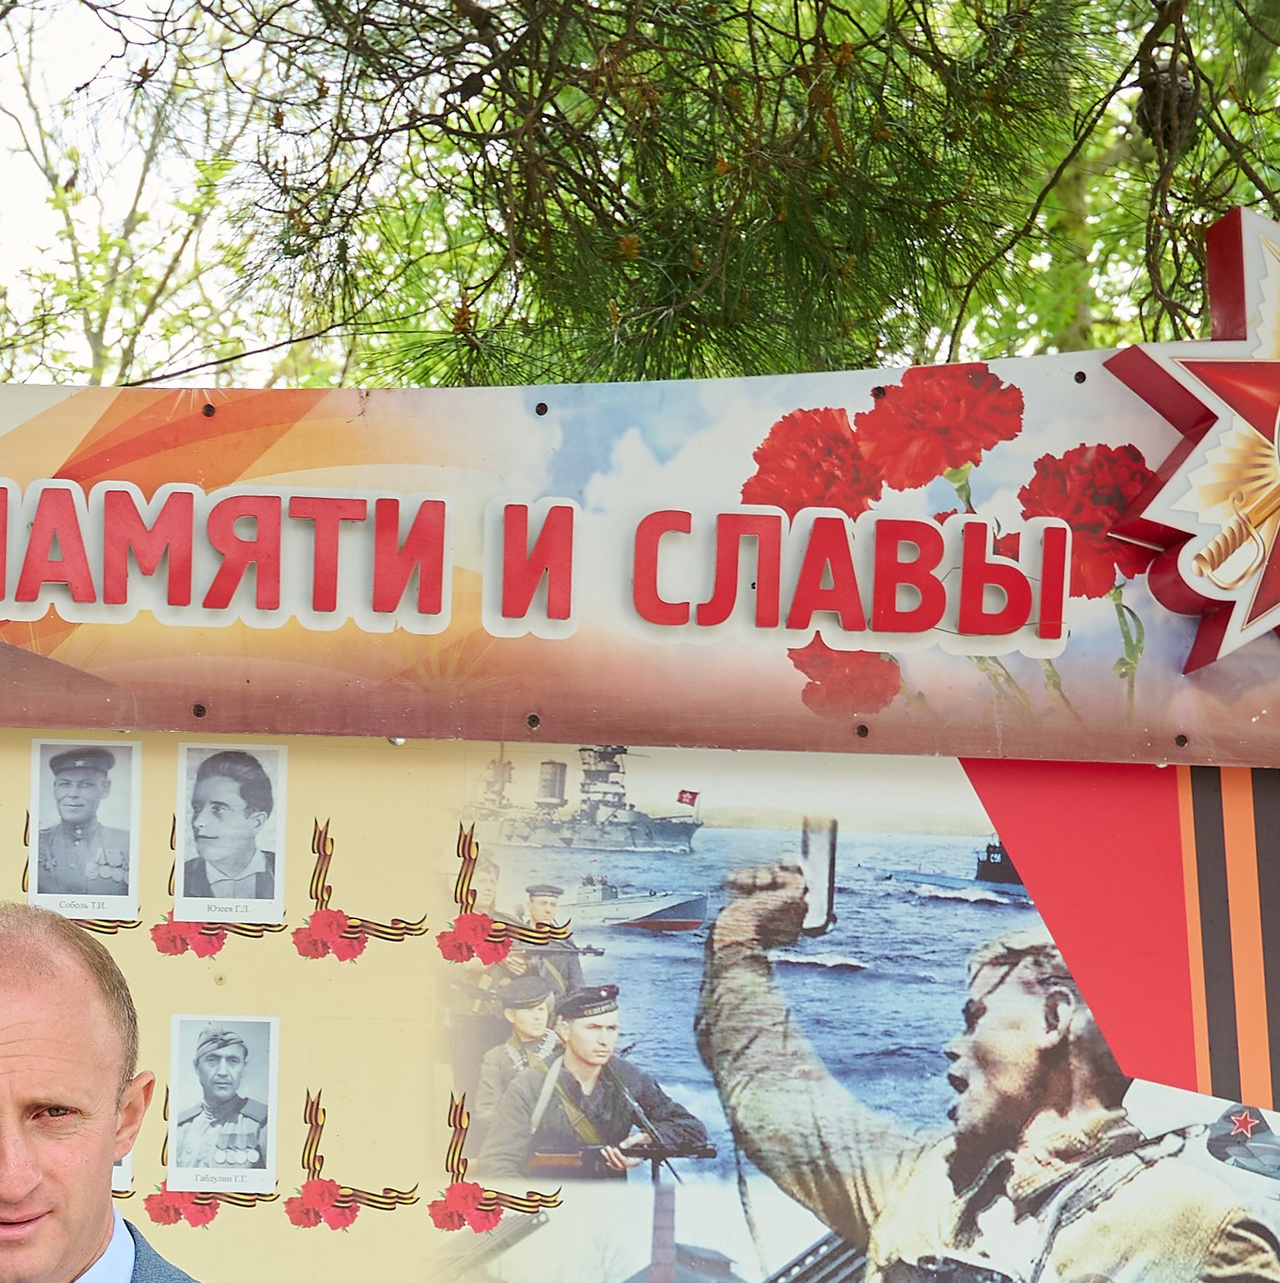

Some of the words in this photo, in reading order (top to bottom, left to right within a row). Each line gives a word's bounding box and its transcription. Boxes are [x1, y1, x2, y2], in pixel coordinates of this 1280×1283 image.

[501, 503, 575, 620] И
[632, 509, 1068, 641] СЛАВЫ
[58, 900, 89, 909] Соболь
